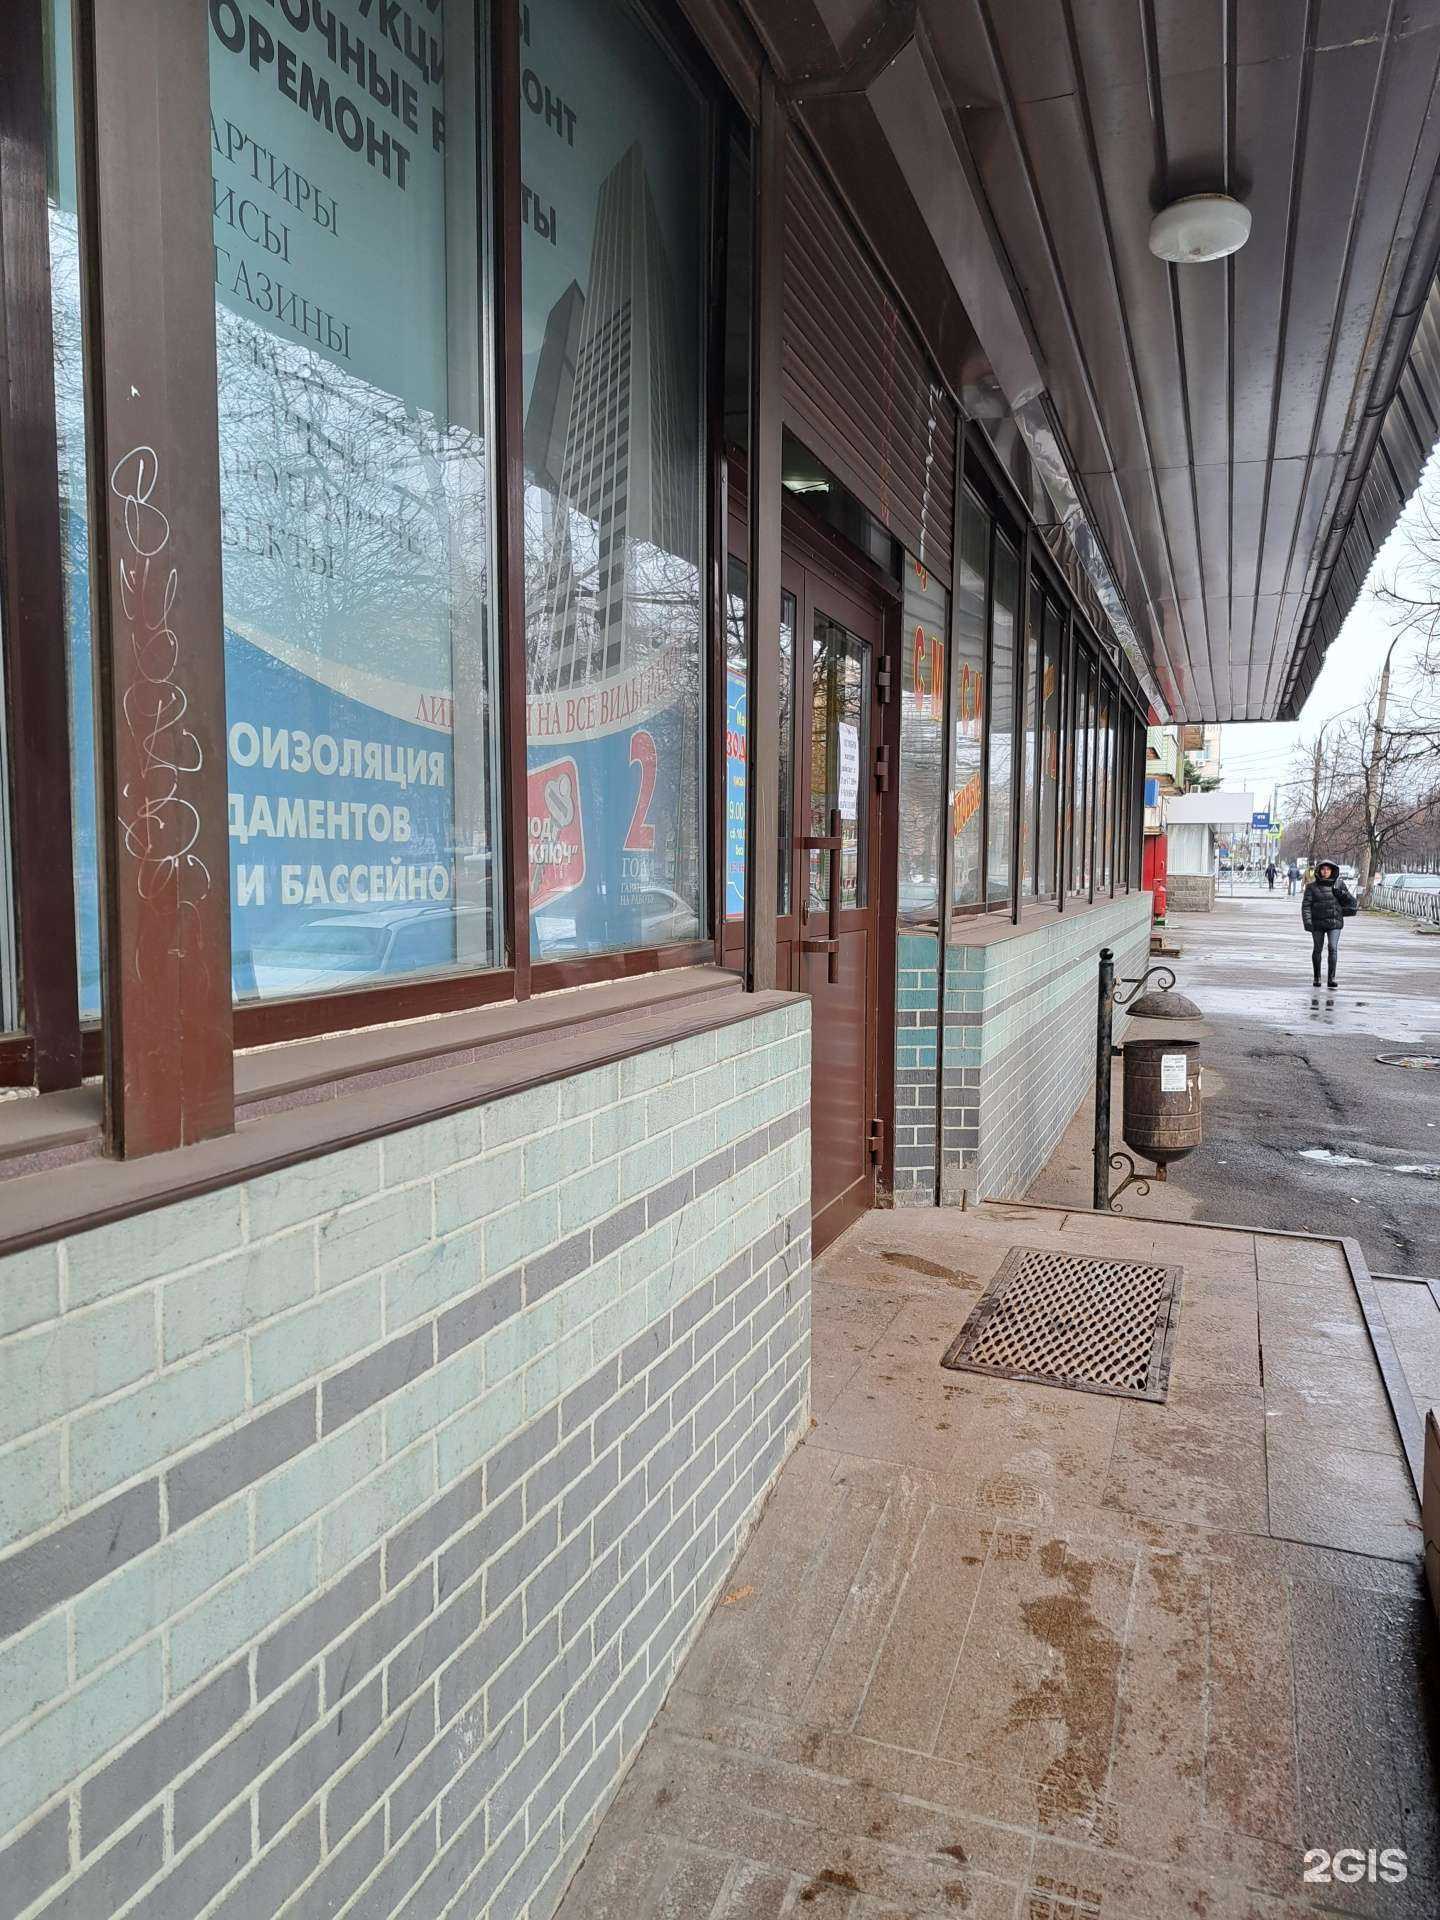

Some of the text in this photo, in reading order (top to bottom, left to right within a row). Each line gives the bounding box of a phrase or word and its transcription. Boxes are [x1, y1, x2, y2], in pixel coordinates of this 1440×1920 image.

[266, 0, 418, 134] ОЧНЫЕ
[537, 702, 562, 736] НА
[565, 696, 597, 733] ВСЕ
[600, 673, 643, 725] ВИДЫ
[228, 721, 445, 790] ОИЗОЛЯЦИЯ
[228, 793, 412, 845] ДАМЕНТОВ
[623, 729, 657, 852] 2
[236, 864, 265, 907] И
